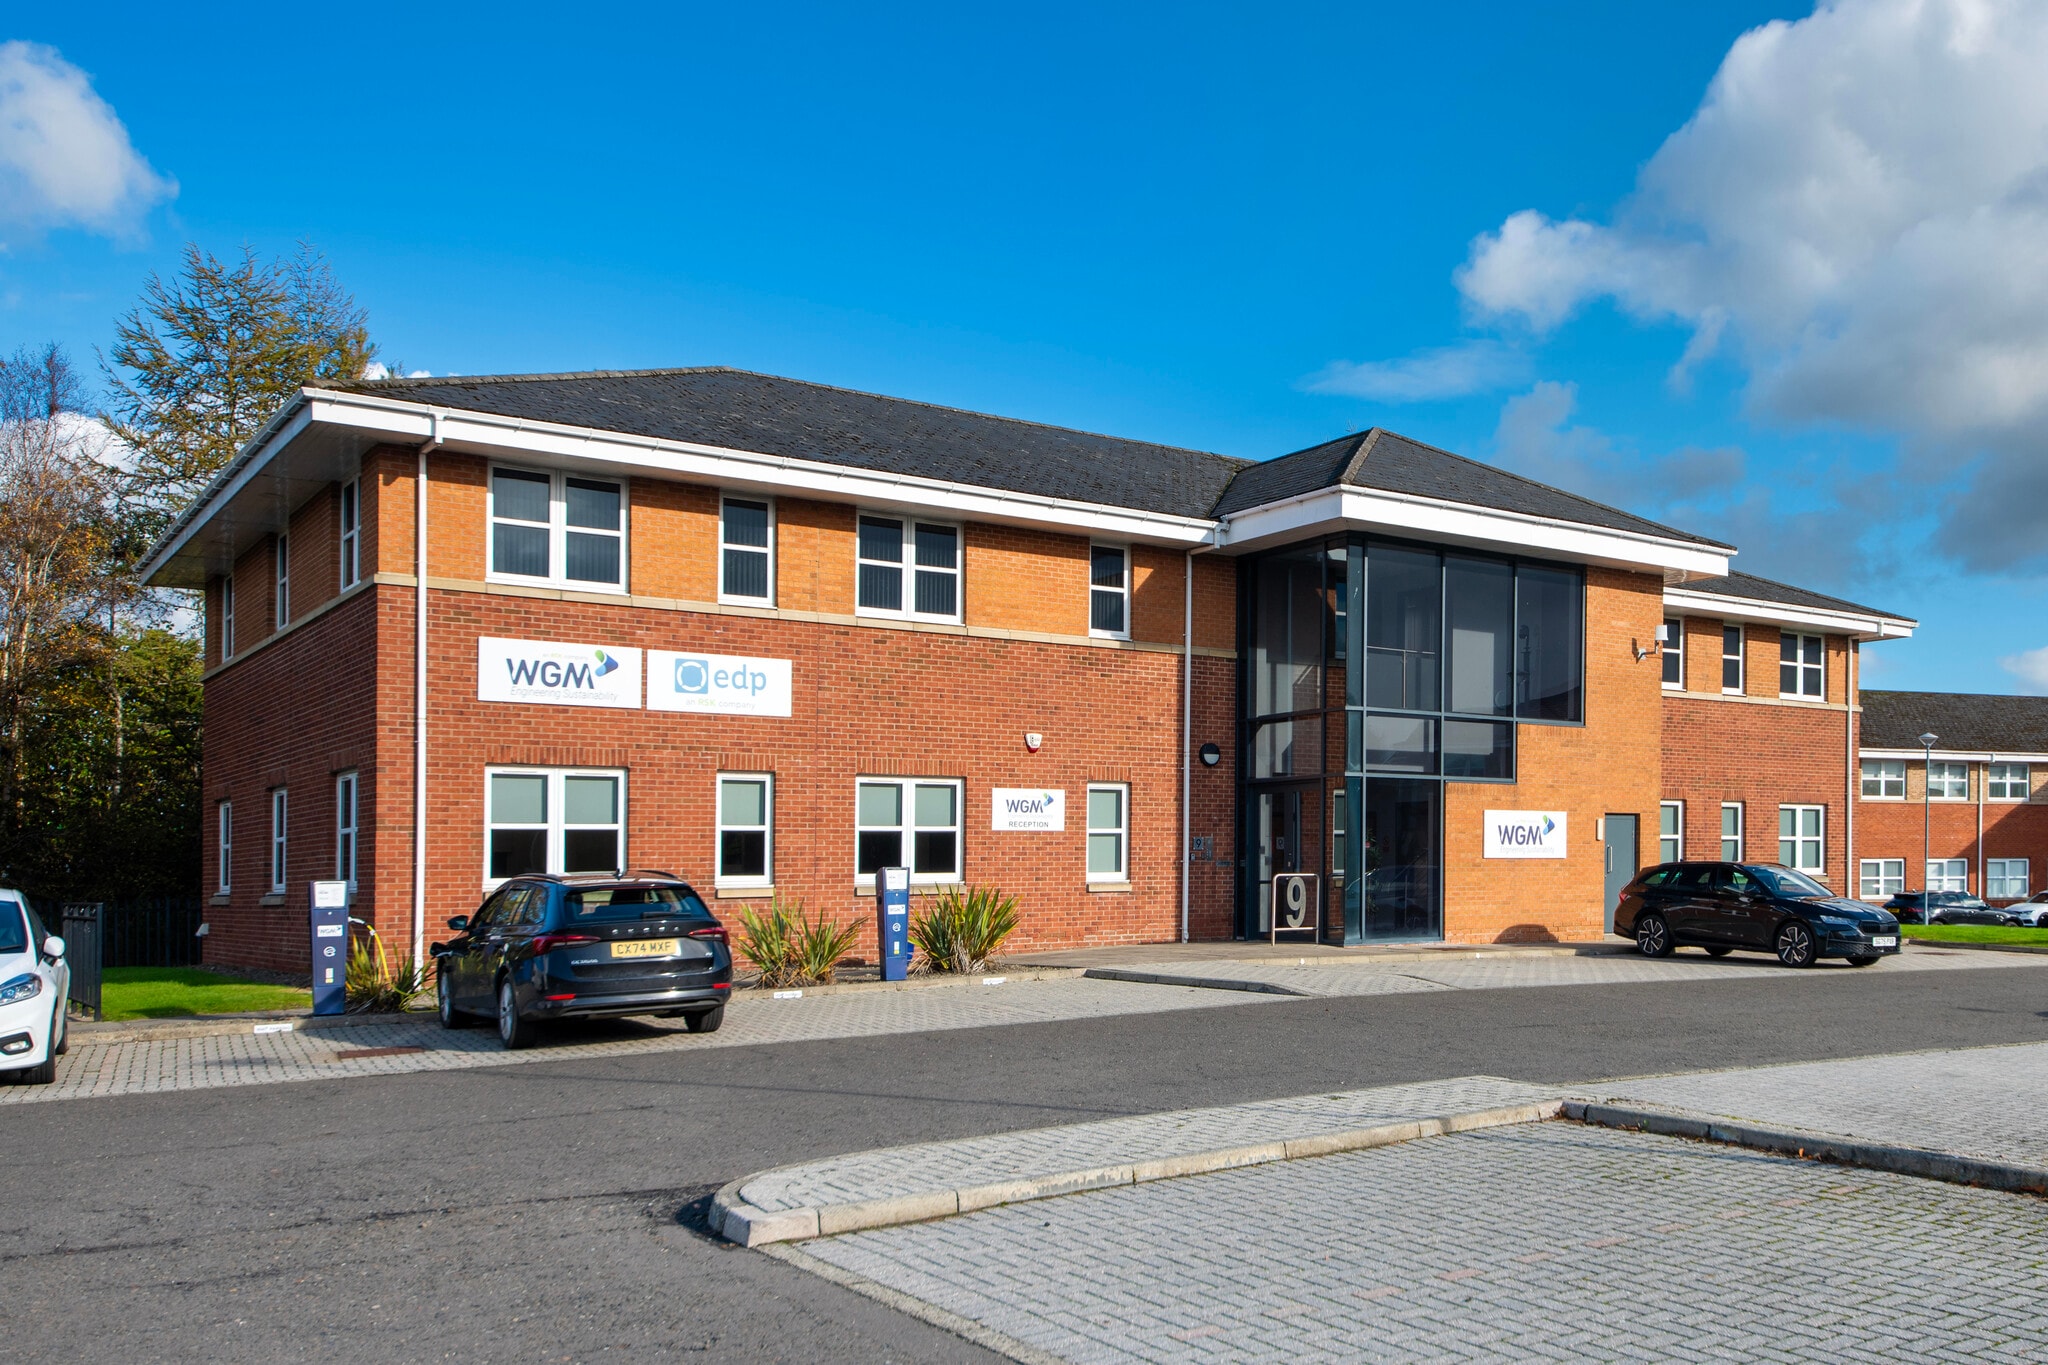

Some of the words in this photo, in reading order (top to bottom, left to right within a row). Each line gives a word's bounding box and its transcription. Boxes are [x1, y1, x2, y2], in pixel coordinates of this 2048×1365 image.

[505, 657, 595, 689] WGM
[714, 664, 767, 696] edp
[1006, 799, 1044, 814] WGM
[1008, 820, 1049, 828] RECEPTION
[1195, 838, 1202, 848] 9
[1498, 825, 1543, 845] WGM
[1286, 877, 1307, 927] 9
[616, 943, 647, 955] CX74
[650, 941, 671, 953] MXF
